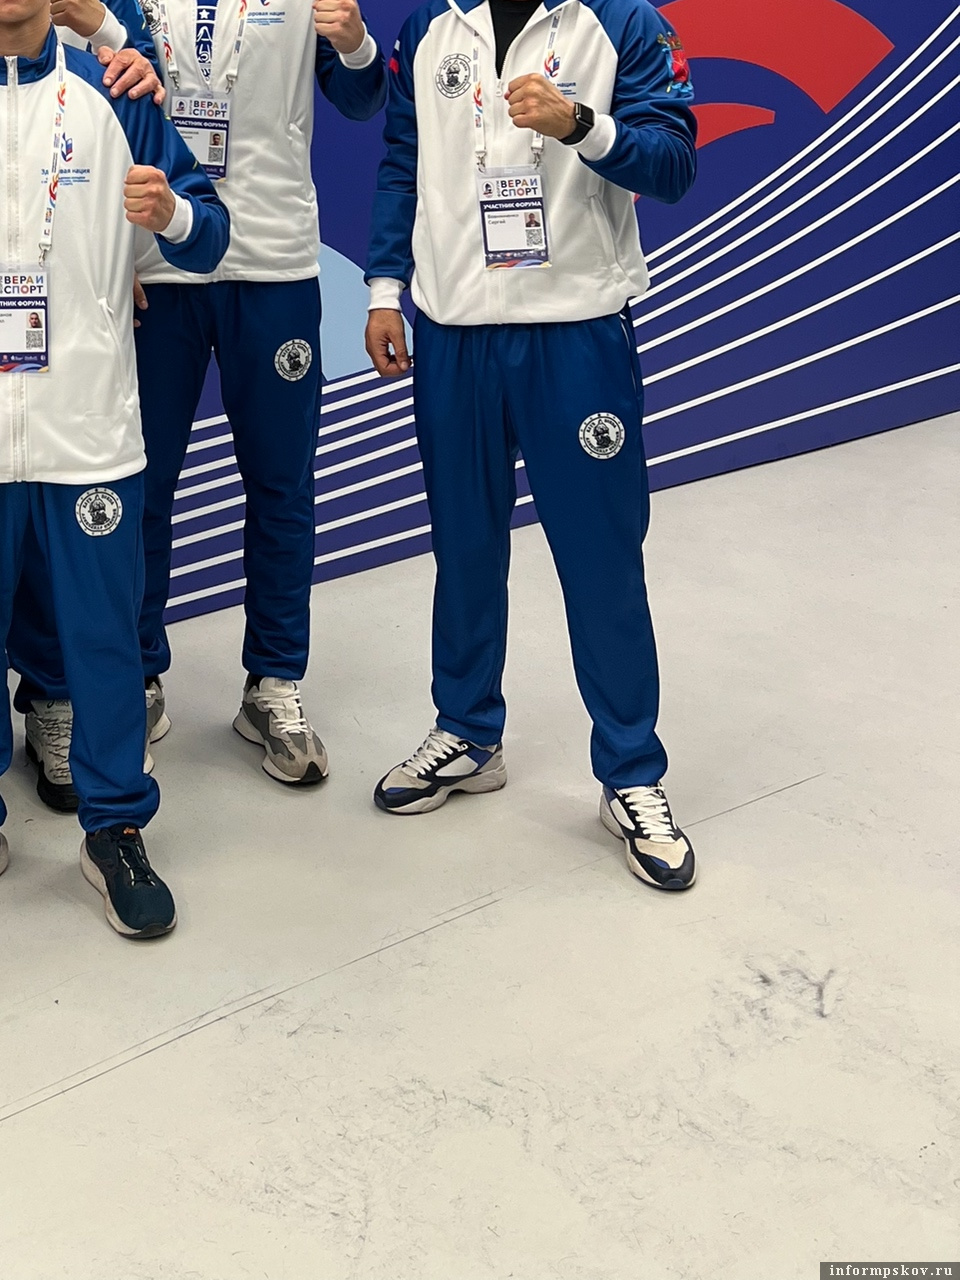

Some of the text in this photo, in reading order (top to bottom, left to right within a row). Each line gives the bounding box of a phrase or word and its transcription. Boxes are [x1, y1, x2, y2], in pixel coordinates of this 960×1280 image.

[193, 100, 219, 109] ВЕРА
[220, 102, 228, 110] И
[192, 108, 227, 118] СПОРТ
[173, 119, 203, 127] УЧАСТНИК
[500, 178, 538, 188] ВЕРА И
[501, 187, 538, 197] СПОРТ
[483, 202, 515, 210] УЧАСТНИК
[4, 275, 44, 285] ВЕРА И
[4, 285, 44, 294] СПОРТ
